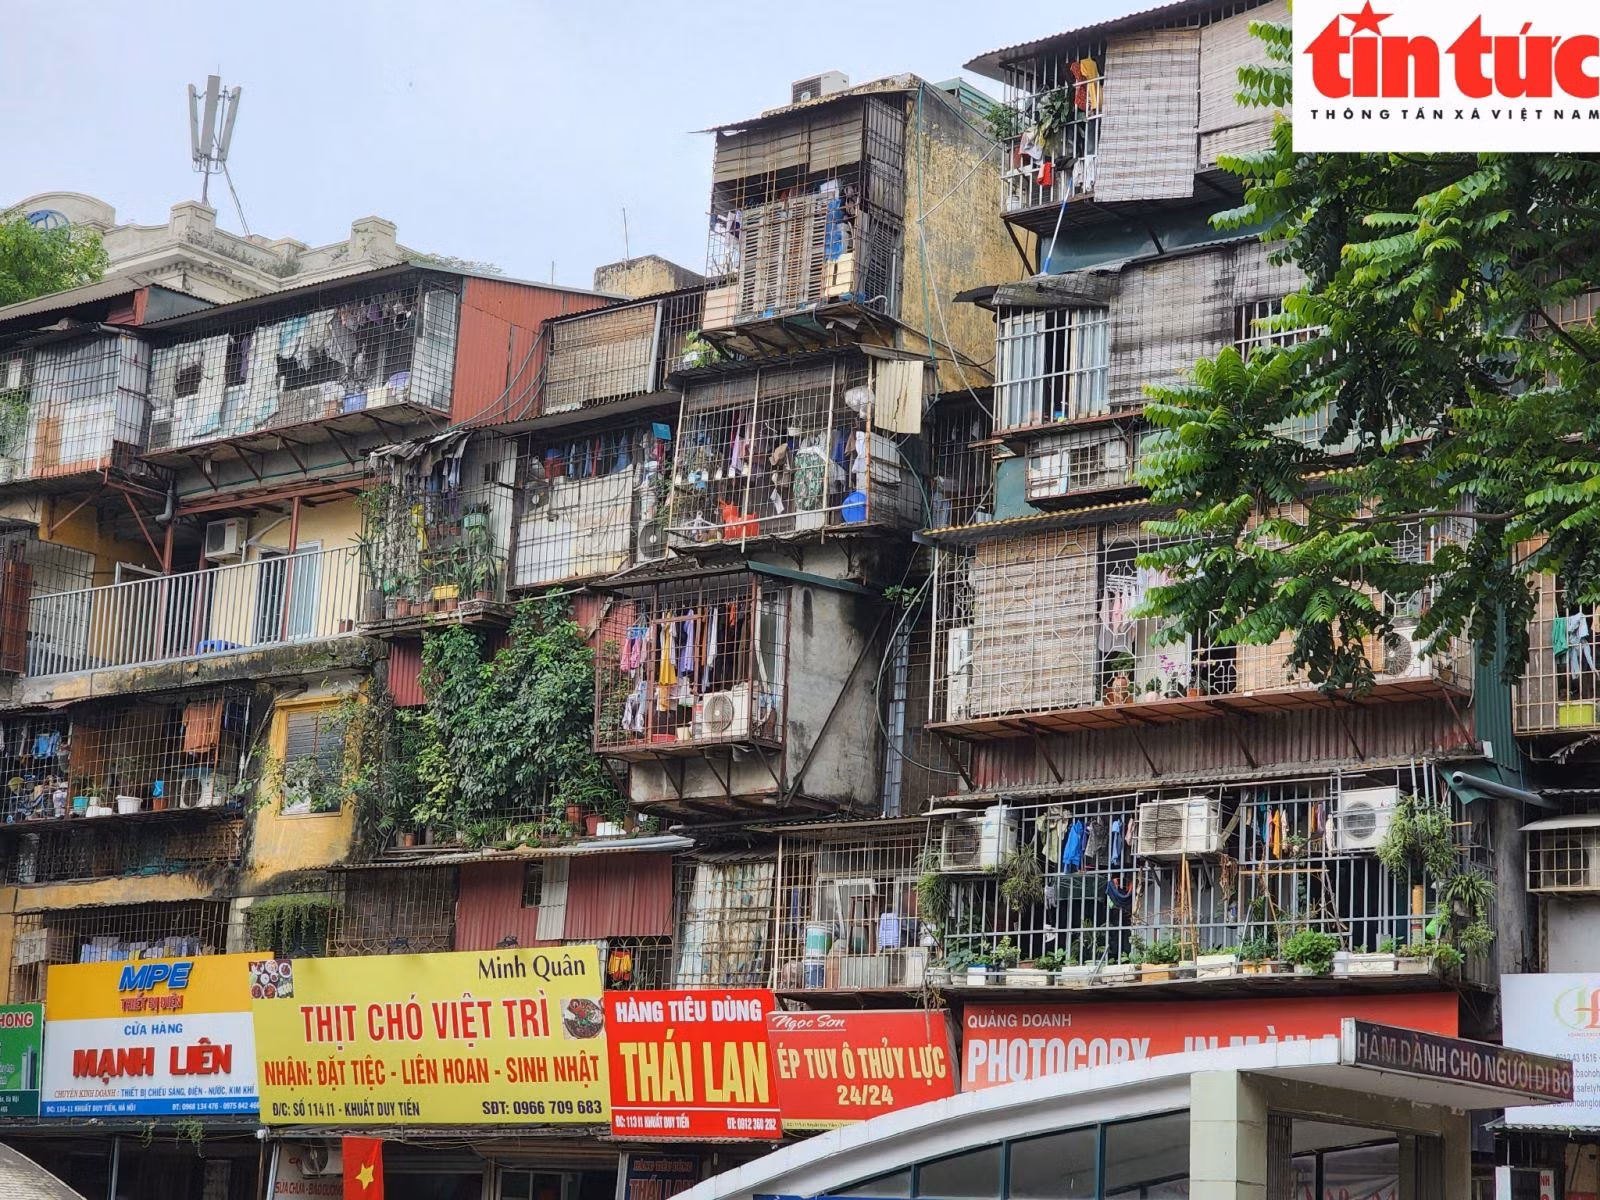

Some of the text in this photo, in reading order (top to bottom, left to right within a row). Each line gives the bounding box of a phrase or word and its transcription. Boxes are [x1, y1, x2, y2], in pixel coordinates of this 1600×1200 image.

[118, 962, 193, 991] MPE
[478, 954, 586, 981] Minh Quân
[300, 989, 550, 1050] THỊT CHÓ VIỆT TRÌ
[615, 995, 763, 1023] HÀNG TIÊU DÙNG
[772, 1014, 846, 1031] Ngọc Sơn
[967, 1009, 1073, 1028] QUẢNG DOANH
[124, 1020, 183, 1036] CỬA HÀNG
[73, 1037, 232, 1085] MẠNH LIÊN
[264, 1055, 313, 1092] NHẬN:
[316, 1054, 346, 1091] ĐẶT
[350, 1054, 386, 1091] TIỆC
[401, 1053, 439, 1085] LIÊN
[442, 1058, 490, 1084] HOAN
[506, 1056, 549, 1083] SINH
[552, 1049, 599, 1088] NHẬT
[619, 1028, 770, 1103] THÁI LAN
[776, 1036, 947, 1086] ÉP TUY Ô THỦY LỰC
[1400, 1033, 1447, 1074] DÀNH
[1451, 1047, 1481, 1080] CHO
[1485, 1054, 1532, 1091] NGƯỜI
[121, 1086, 139, 1097] THIẾT
[148, 1085, 166, 1097] CHIẾU
[229, 1086, 241, 1095] KIM
[242, 1083, 255, 1095] KHÍ
[836, 1084, 894, 1106] 24/24
[272, 1102, 291, 1117] Đ/C:
[293, 1096, 306, 1117] SỐ
[308, 1102, 325, 1117] 114
[344, 1096, 375, 1117] KHUẤT
[377, 1102, 395, 1117] DUY
[397, 1096, 421, 1117] TIẾN
[482, 1100, 603, 1115] SĐT: 0966 709 683
